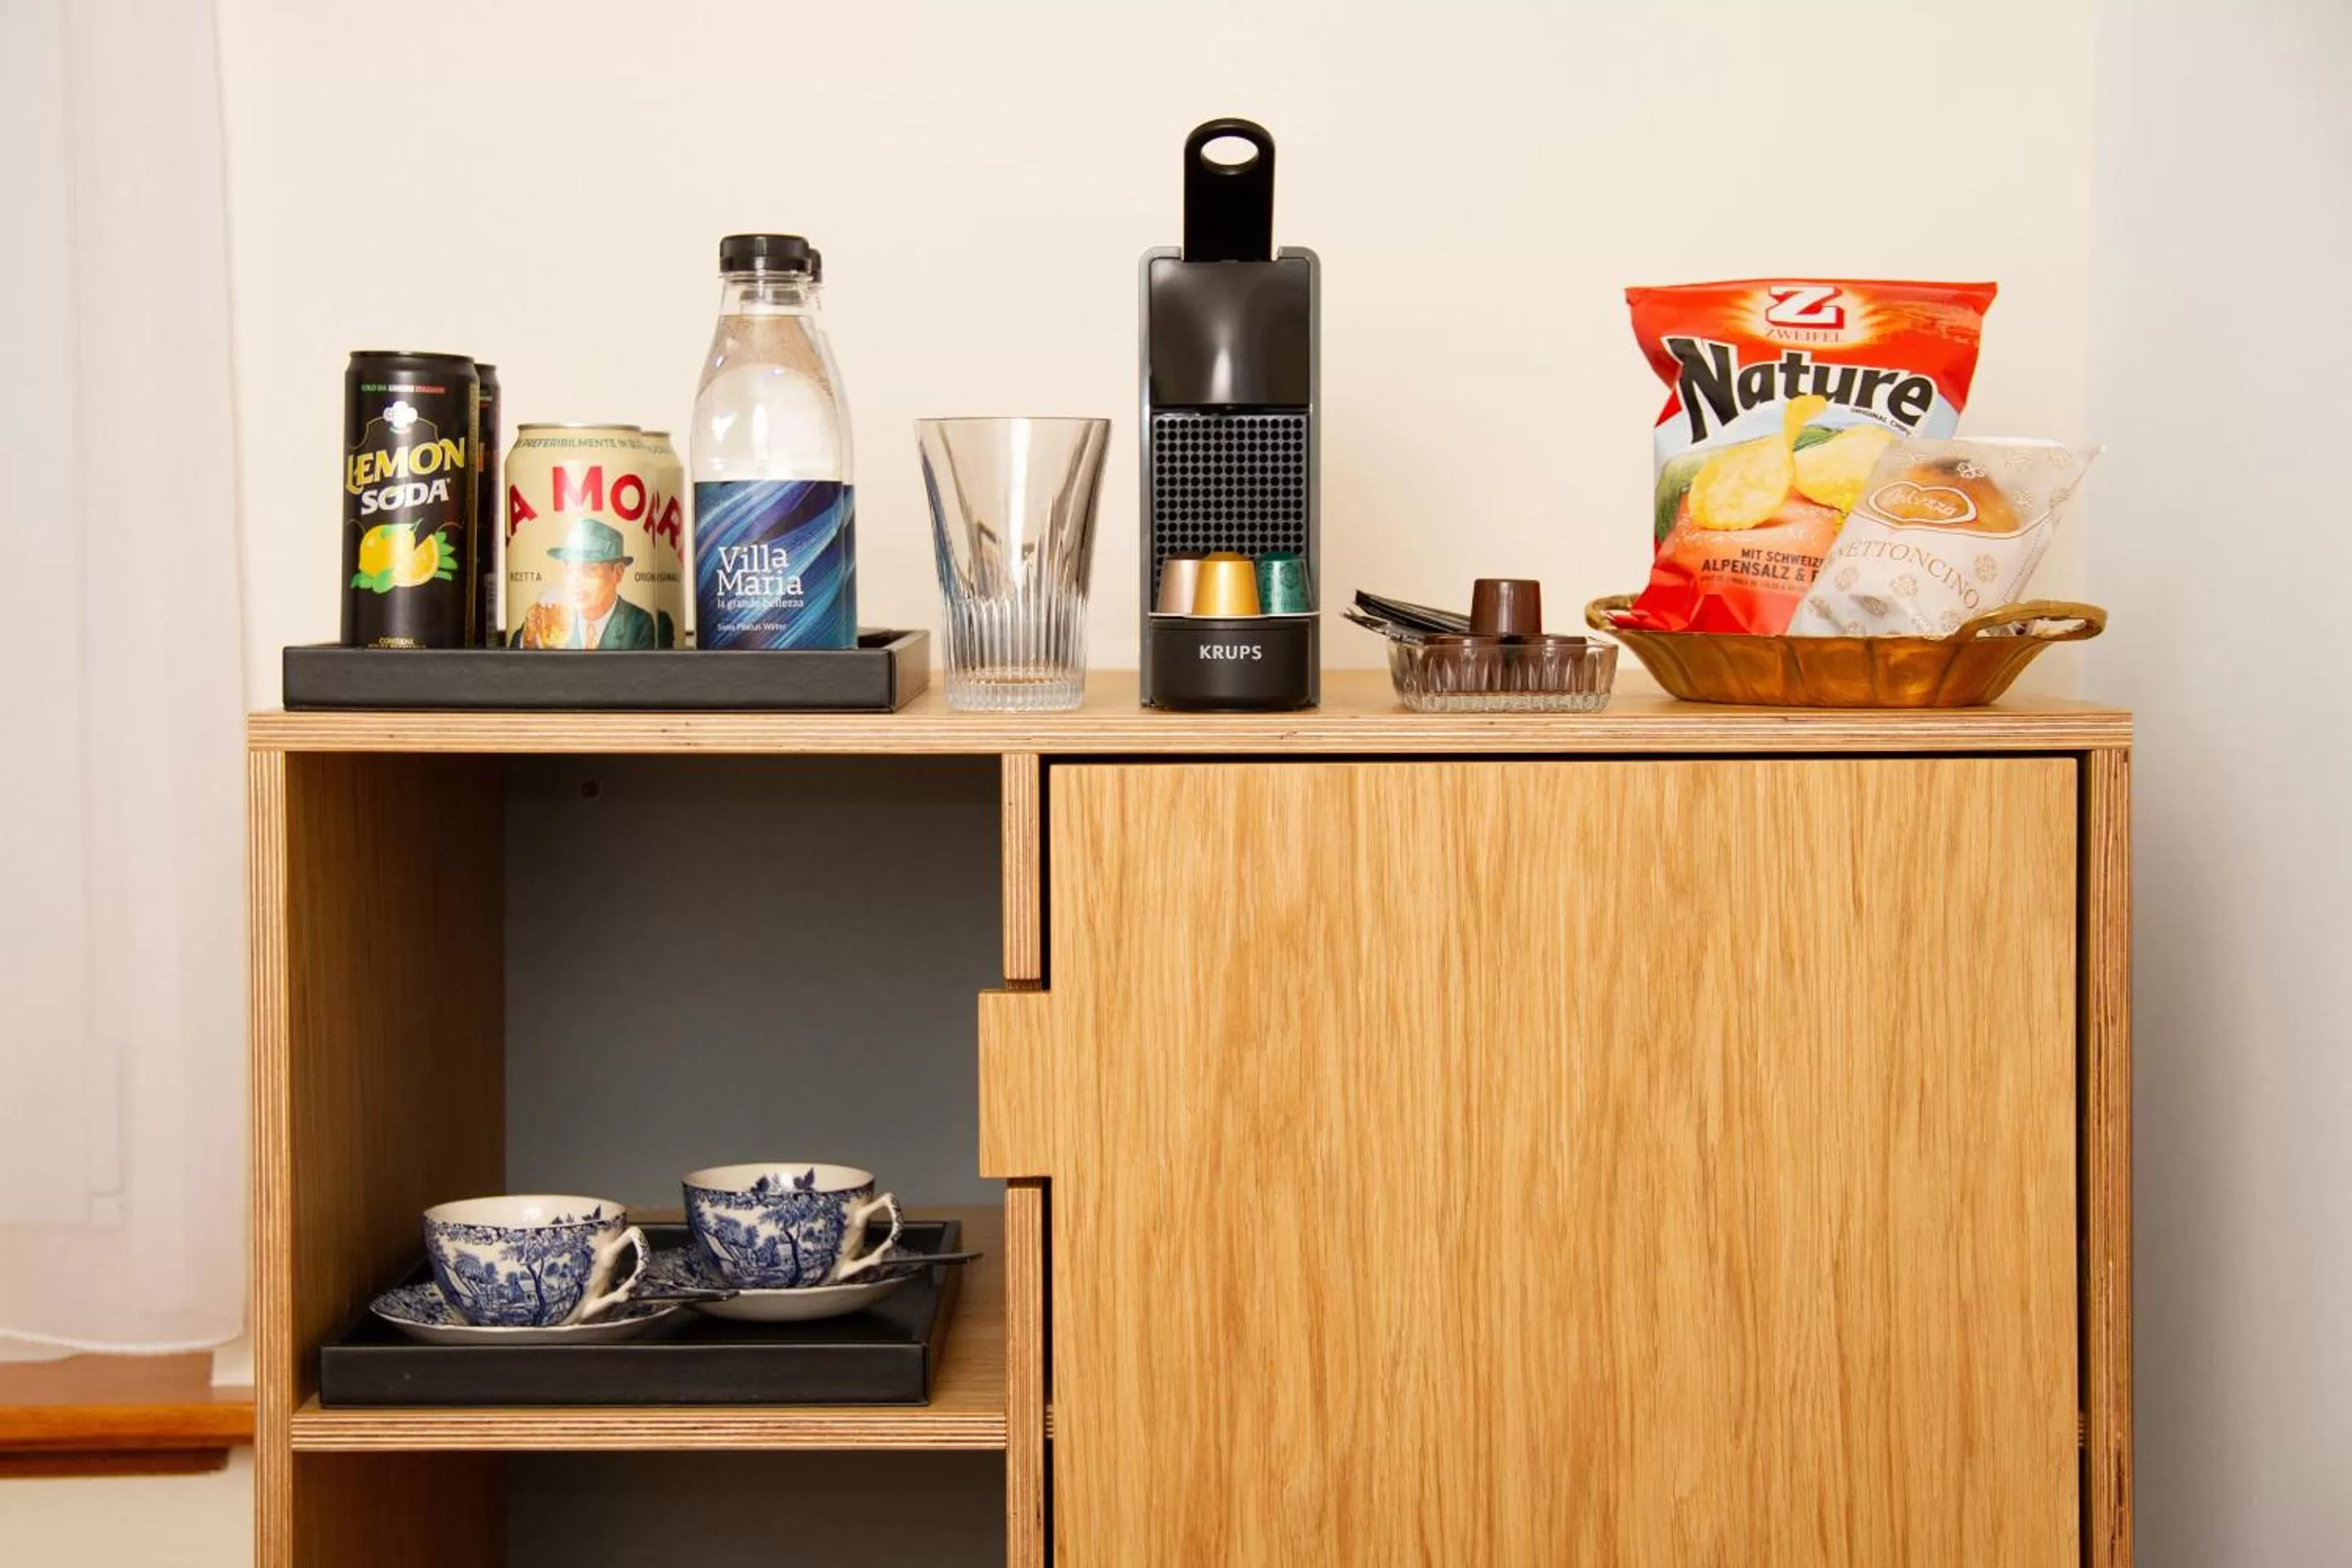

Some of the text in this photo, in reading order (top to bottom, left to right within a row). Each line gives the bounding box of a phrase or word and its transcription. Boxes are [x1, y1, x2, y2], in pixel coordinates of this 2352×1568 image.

[1766, 286, 1844, 329] Z
[1765, 328, 1845, 343] ZWEIFEL
[1667, 338, 1933, 444] Nature
[1850, 408, 1887, 423] ORIGINAL
[345, 437, 466, 494] LEMON
[360, 479, 450, 515] SODA
[718, 544, 788, 572] Villa
[1741, 549, 1763, 559] MIT
[716, 569, 804, 595] Maria
[1701, 559, 1790, 581] ALPENSALZ
[717, 598, 725, 608] la
[1200, 645, 1262, 660] KRUPS
